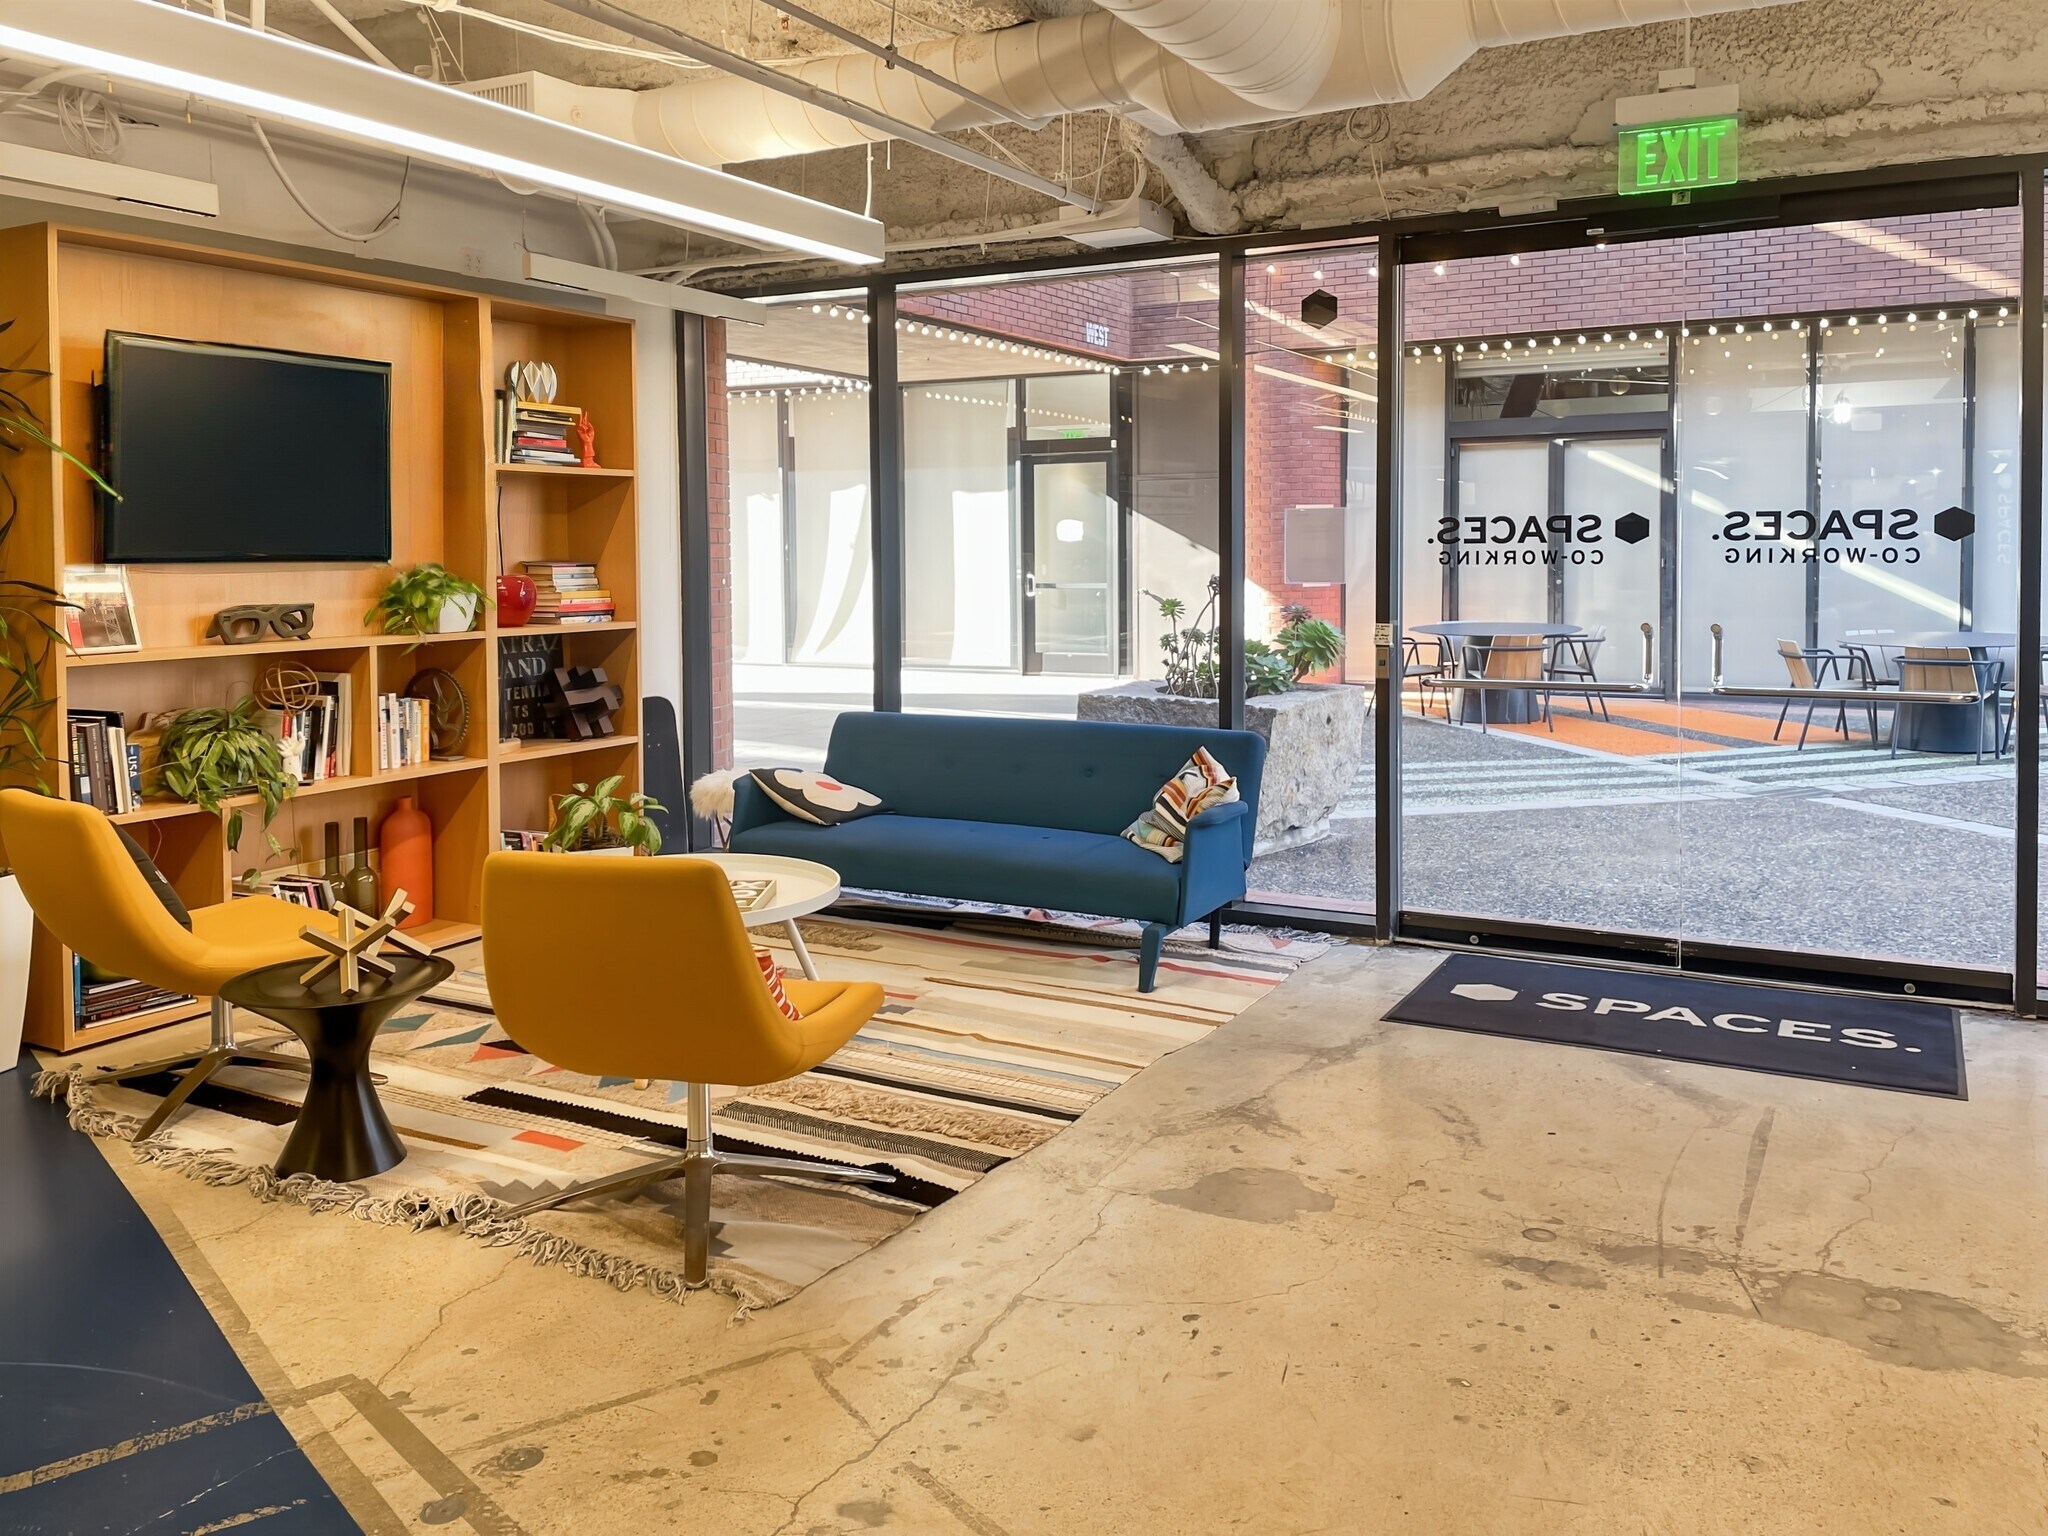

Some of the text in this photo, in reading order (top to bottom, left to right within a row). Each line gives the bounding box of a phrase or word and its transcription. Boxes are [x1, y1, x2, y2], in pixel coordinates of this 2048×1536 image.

[1637, 125, 1726, 186] EXIT
[1086, 322, 1109, 347] WEST
[128, 755, 138, 778] USA
[1535, 992, 1922, 1053] SPACES.
